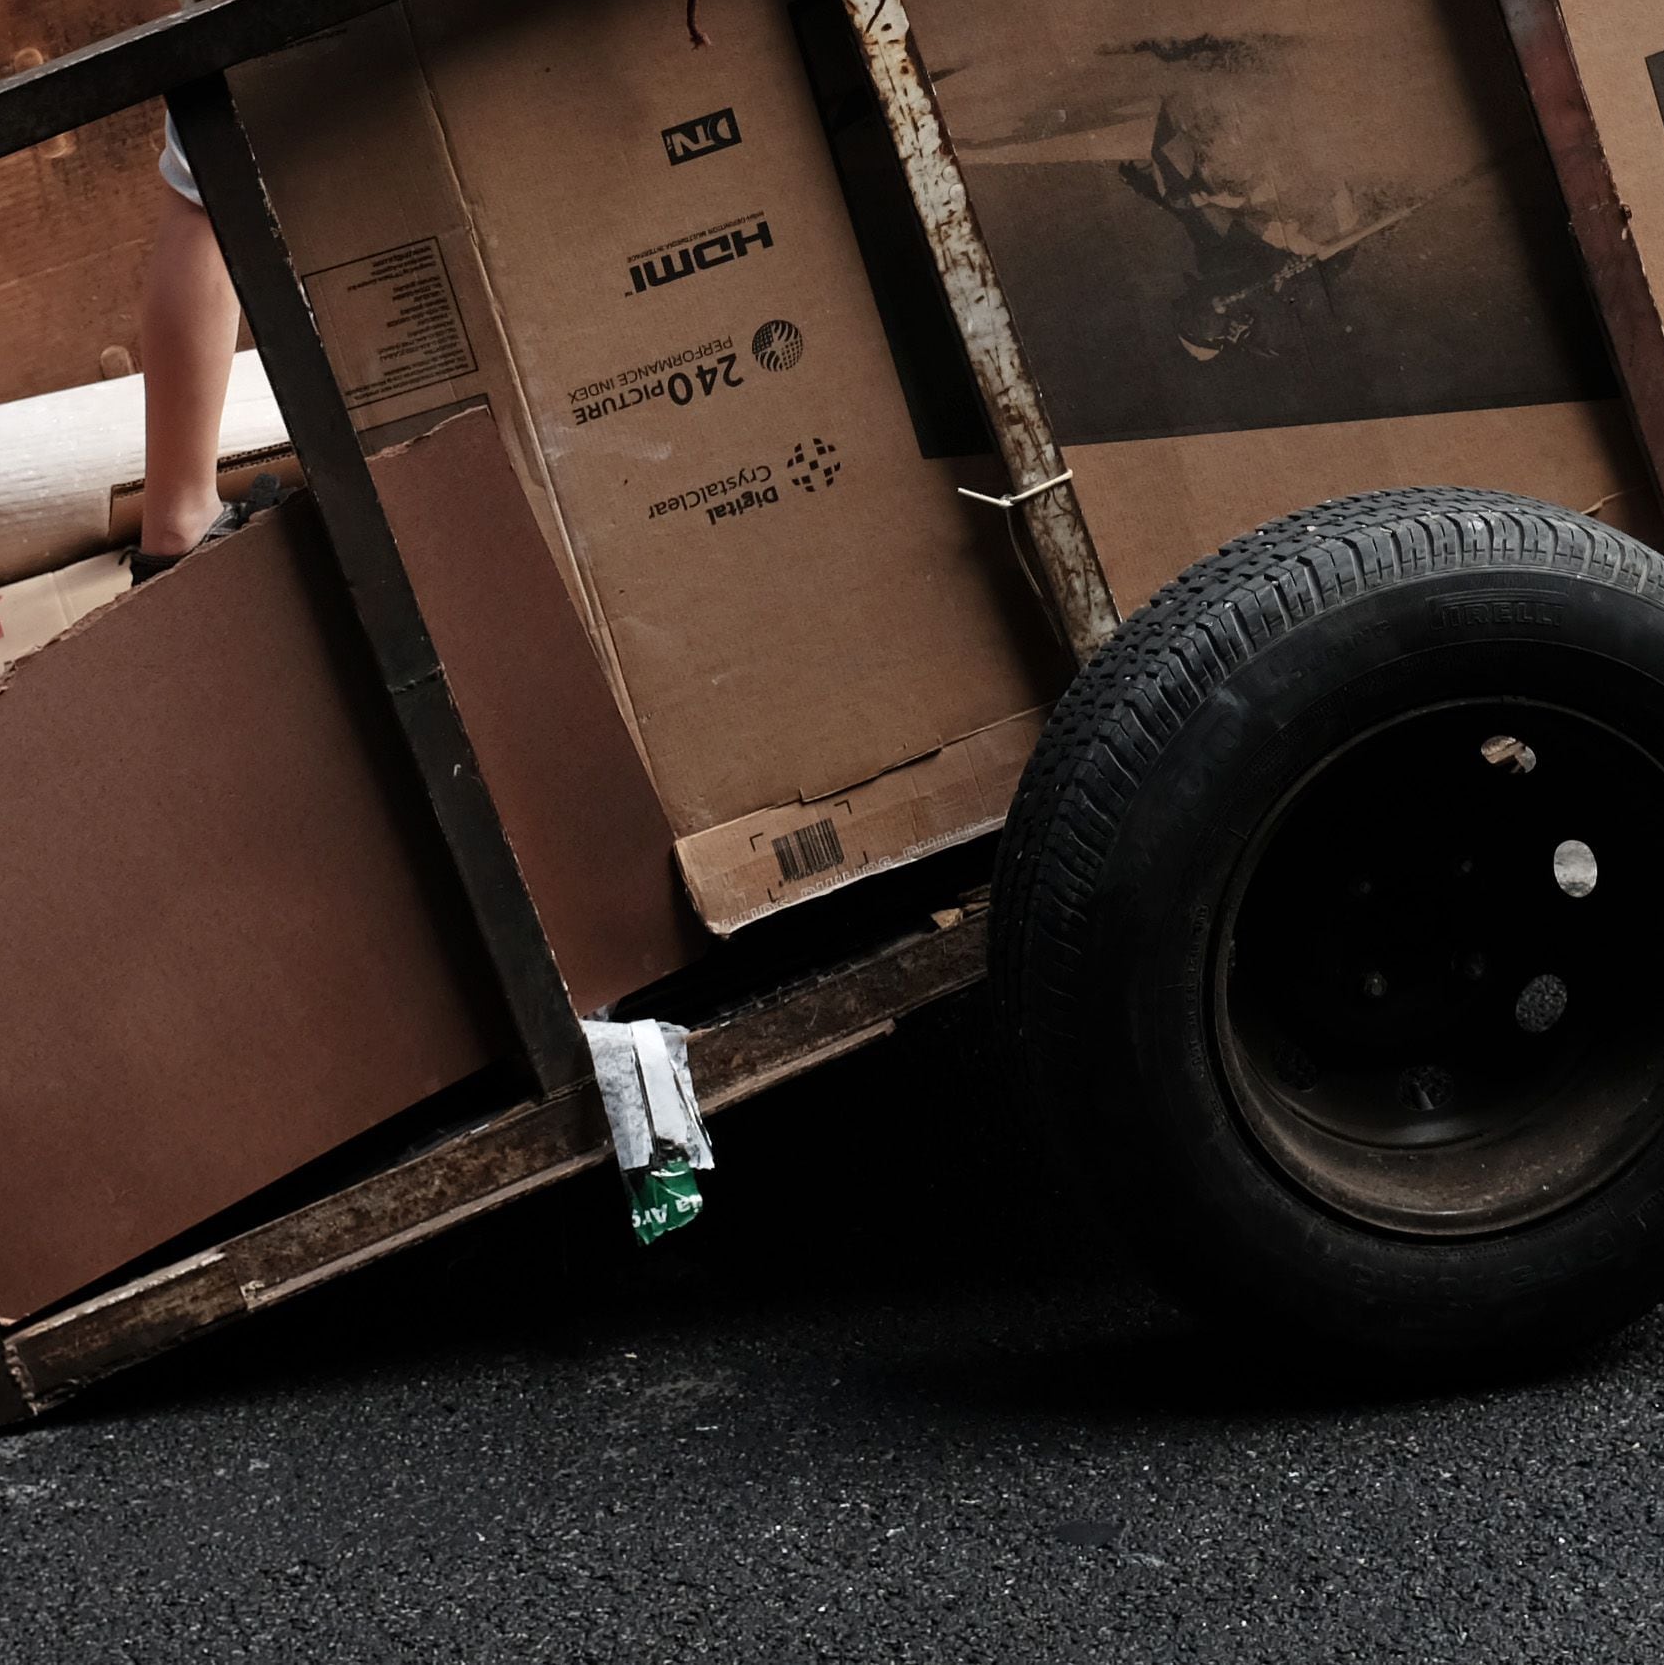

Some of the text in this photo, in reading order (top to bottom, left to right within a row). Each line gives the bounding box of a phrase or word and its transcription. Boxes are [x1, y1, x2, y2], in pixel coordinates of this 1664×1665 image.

[568, 336, 734, 403] PERFORMANCE INDEX
[573, 353, 744, 425] 240 PICTURE
[648, 466, 772, 519] CrystalClear
[705, 486, 779, 525] Digital
